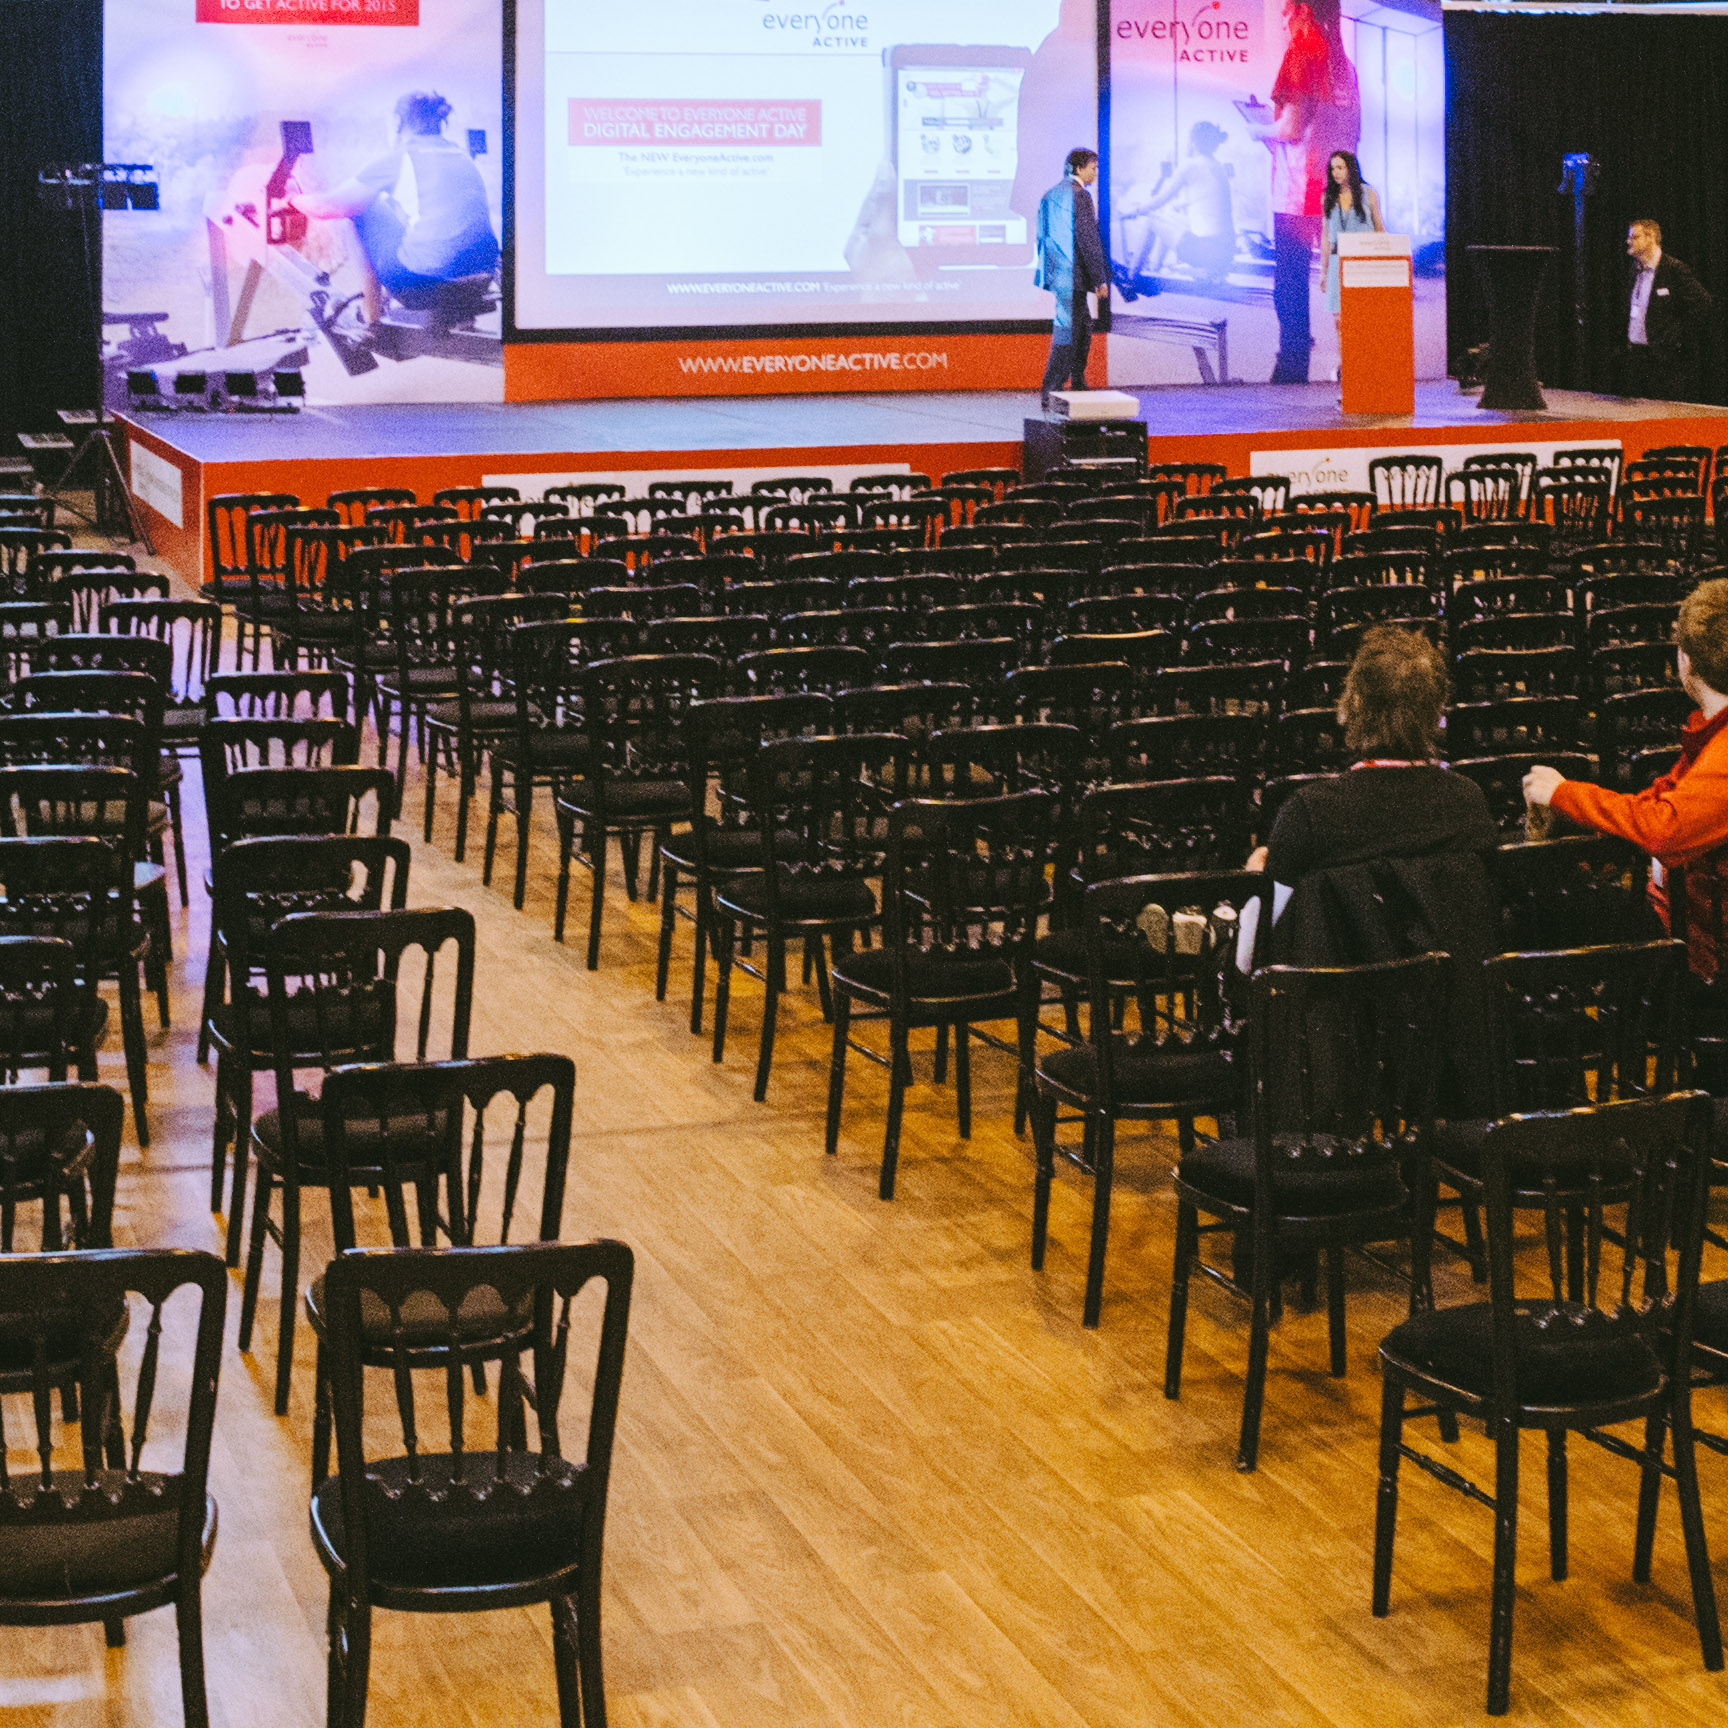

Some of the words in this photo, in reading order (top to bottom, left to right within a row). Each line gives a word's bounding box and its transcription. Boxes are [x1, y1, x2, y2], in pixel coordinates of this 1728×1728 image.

[365, 0, 396, 12] 2015
[762, 4, 869, 33] everyone
[1117, 10, 1249, 46] everyone
[812, 37, 869, 48] ACTIVE
[1179, 49, 1249, 63] ACTIVE
[583, 107, 657, 122] WELCOME
[660, 107, 681, 122] TO
[684, 107, 755, 122] EVERYONE
[758, 108, 806, 122] ACTIVE
[583, 123, 650, 138] DIGITAL
[654, 124, 770, 139] ENGAGEMENT
[774, 124, 807, 139] DAY
[618, 152, 637, 162] The
[640, 153, 669, 162] NEW
[678, 352, 948, 374] WWW.EVERYONEACTIVE.COM
